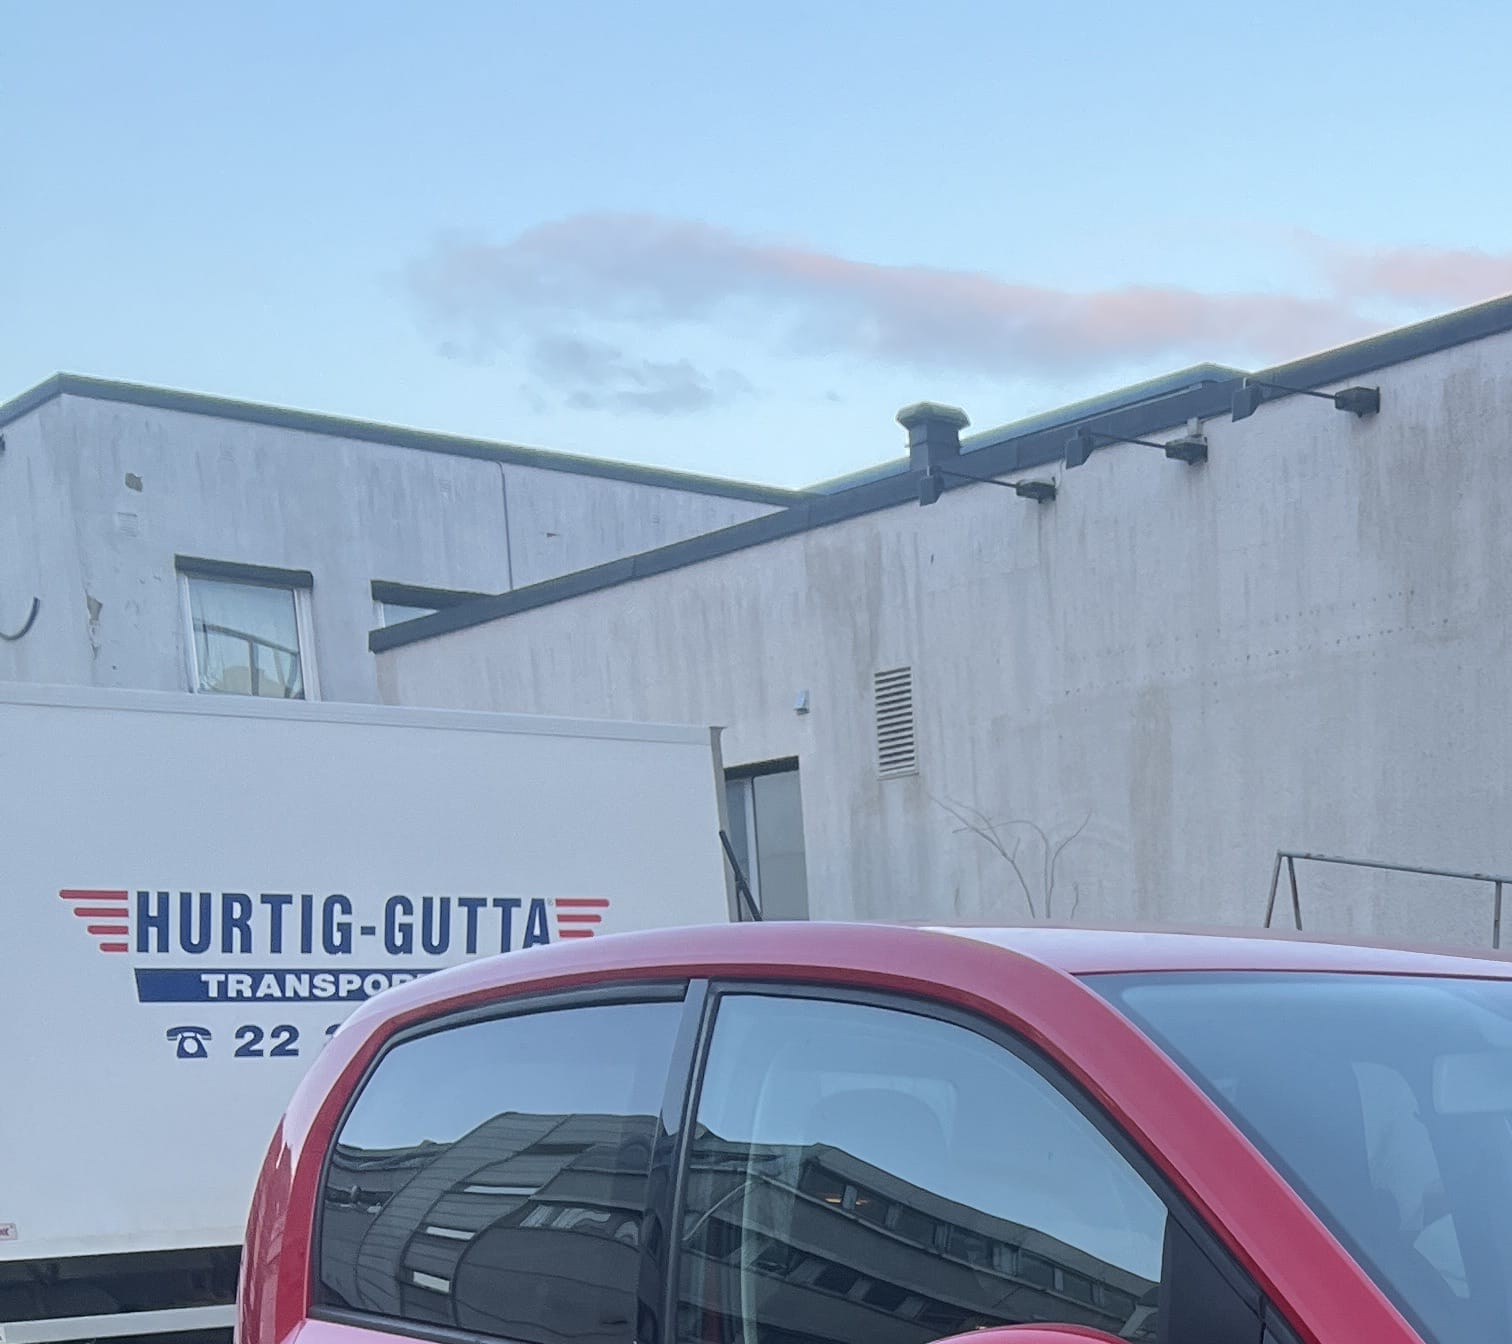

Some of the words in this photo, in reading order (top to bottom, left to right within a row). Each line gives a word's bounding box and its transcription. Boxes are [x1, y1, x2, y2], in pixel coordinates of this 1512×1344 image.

[136, 890, 549, 955] HURTIG-GUTTA
[200, 973, 427, 998] TRANSPO
[234, 1024, 299, 1057] 22
